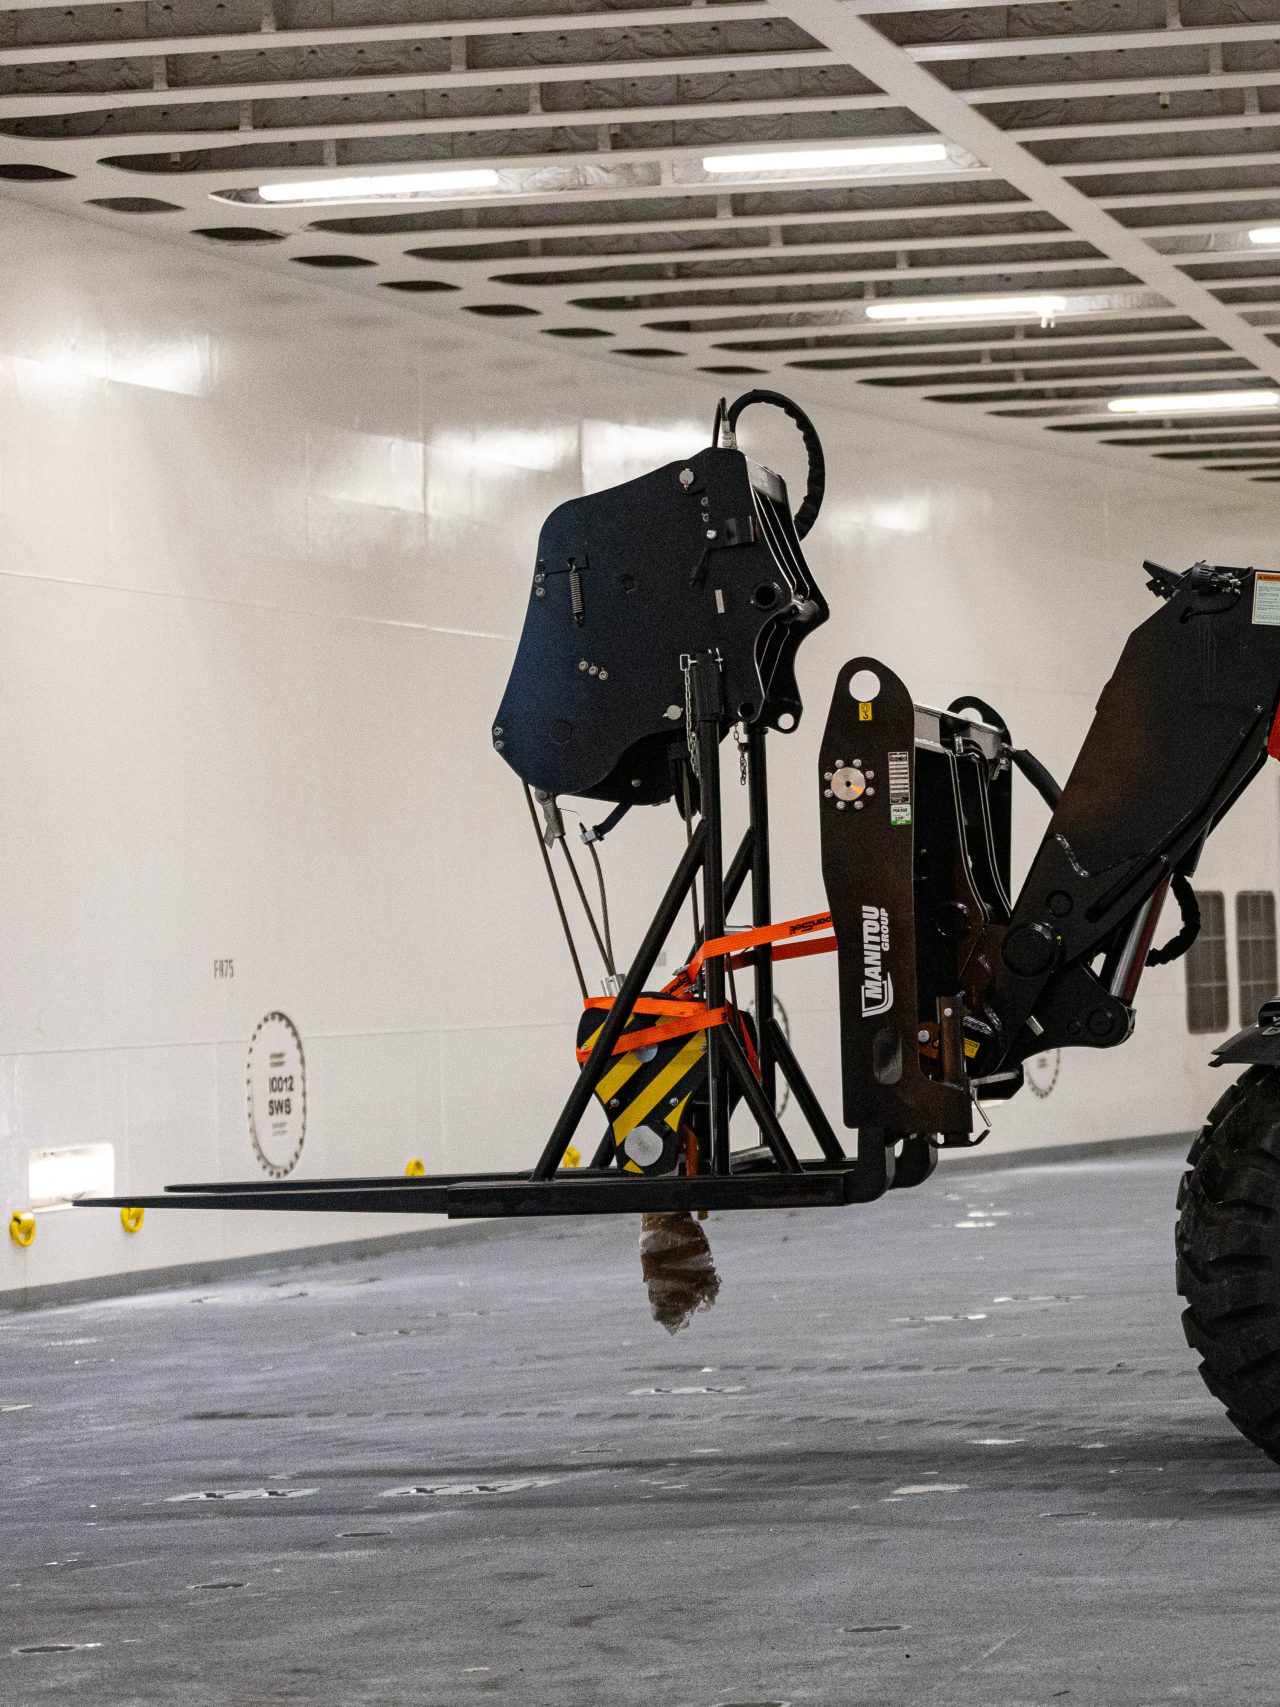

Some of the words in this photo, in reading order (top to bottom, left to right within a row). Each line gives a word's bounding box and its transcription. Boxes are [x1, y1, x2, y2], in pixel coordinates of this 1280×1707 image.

[880, 907, 890, 952] GROUP
[862, 905, 882, 999] MANITOU
[268, 1075, 294, 1093] 10012
[268, 1098, 292, 1117] SWB
